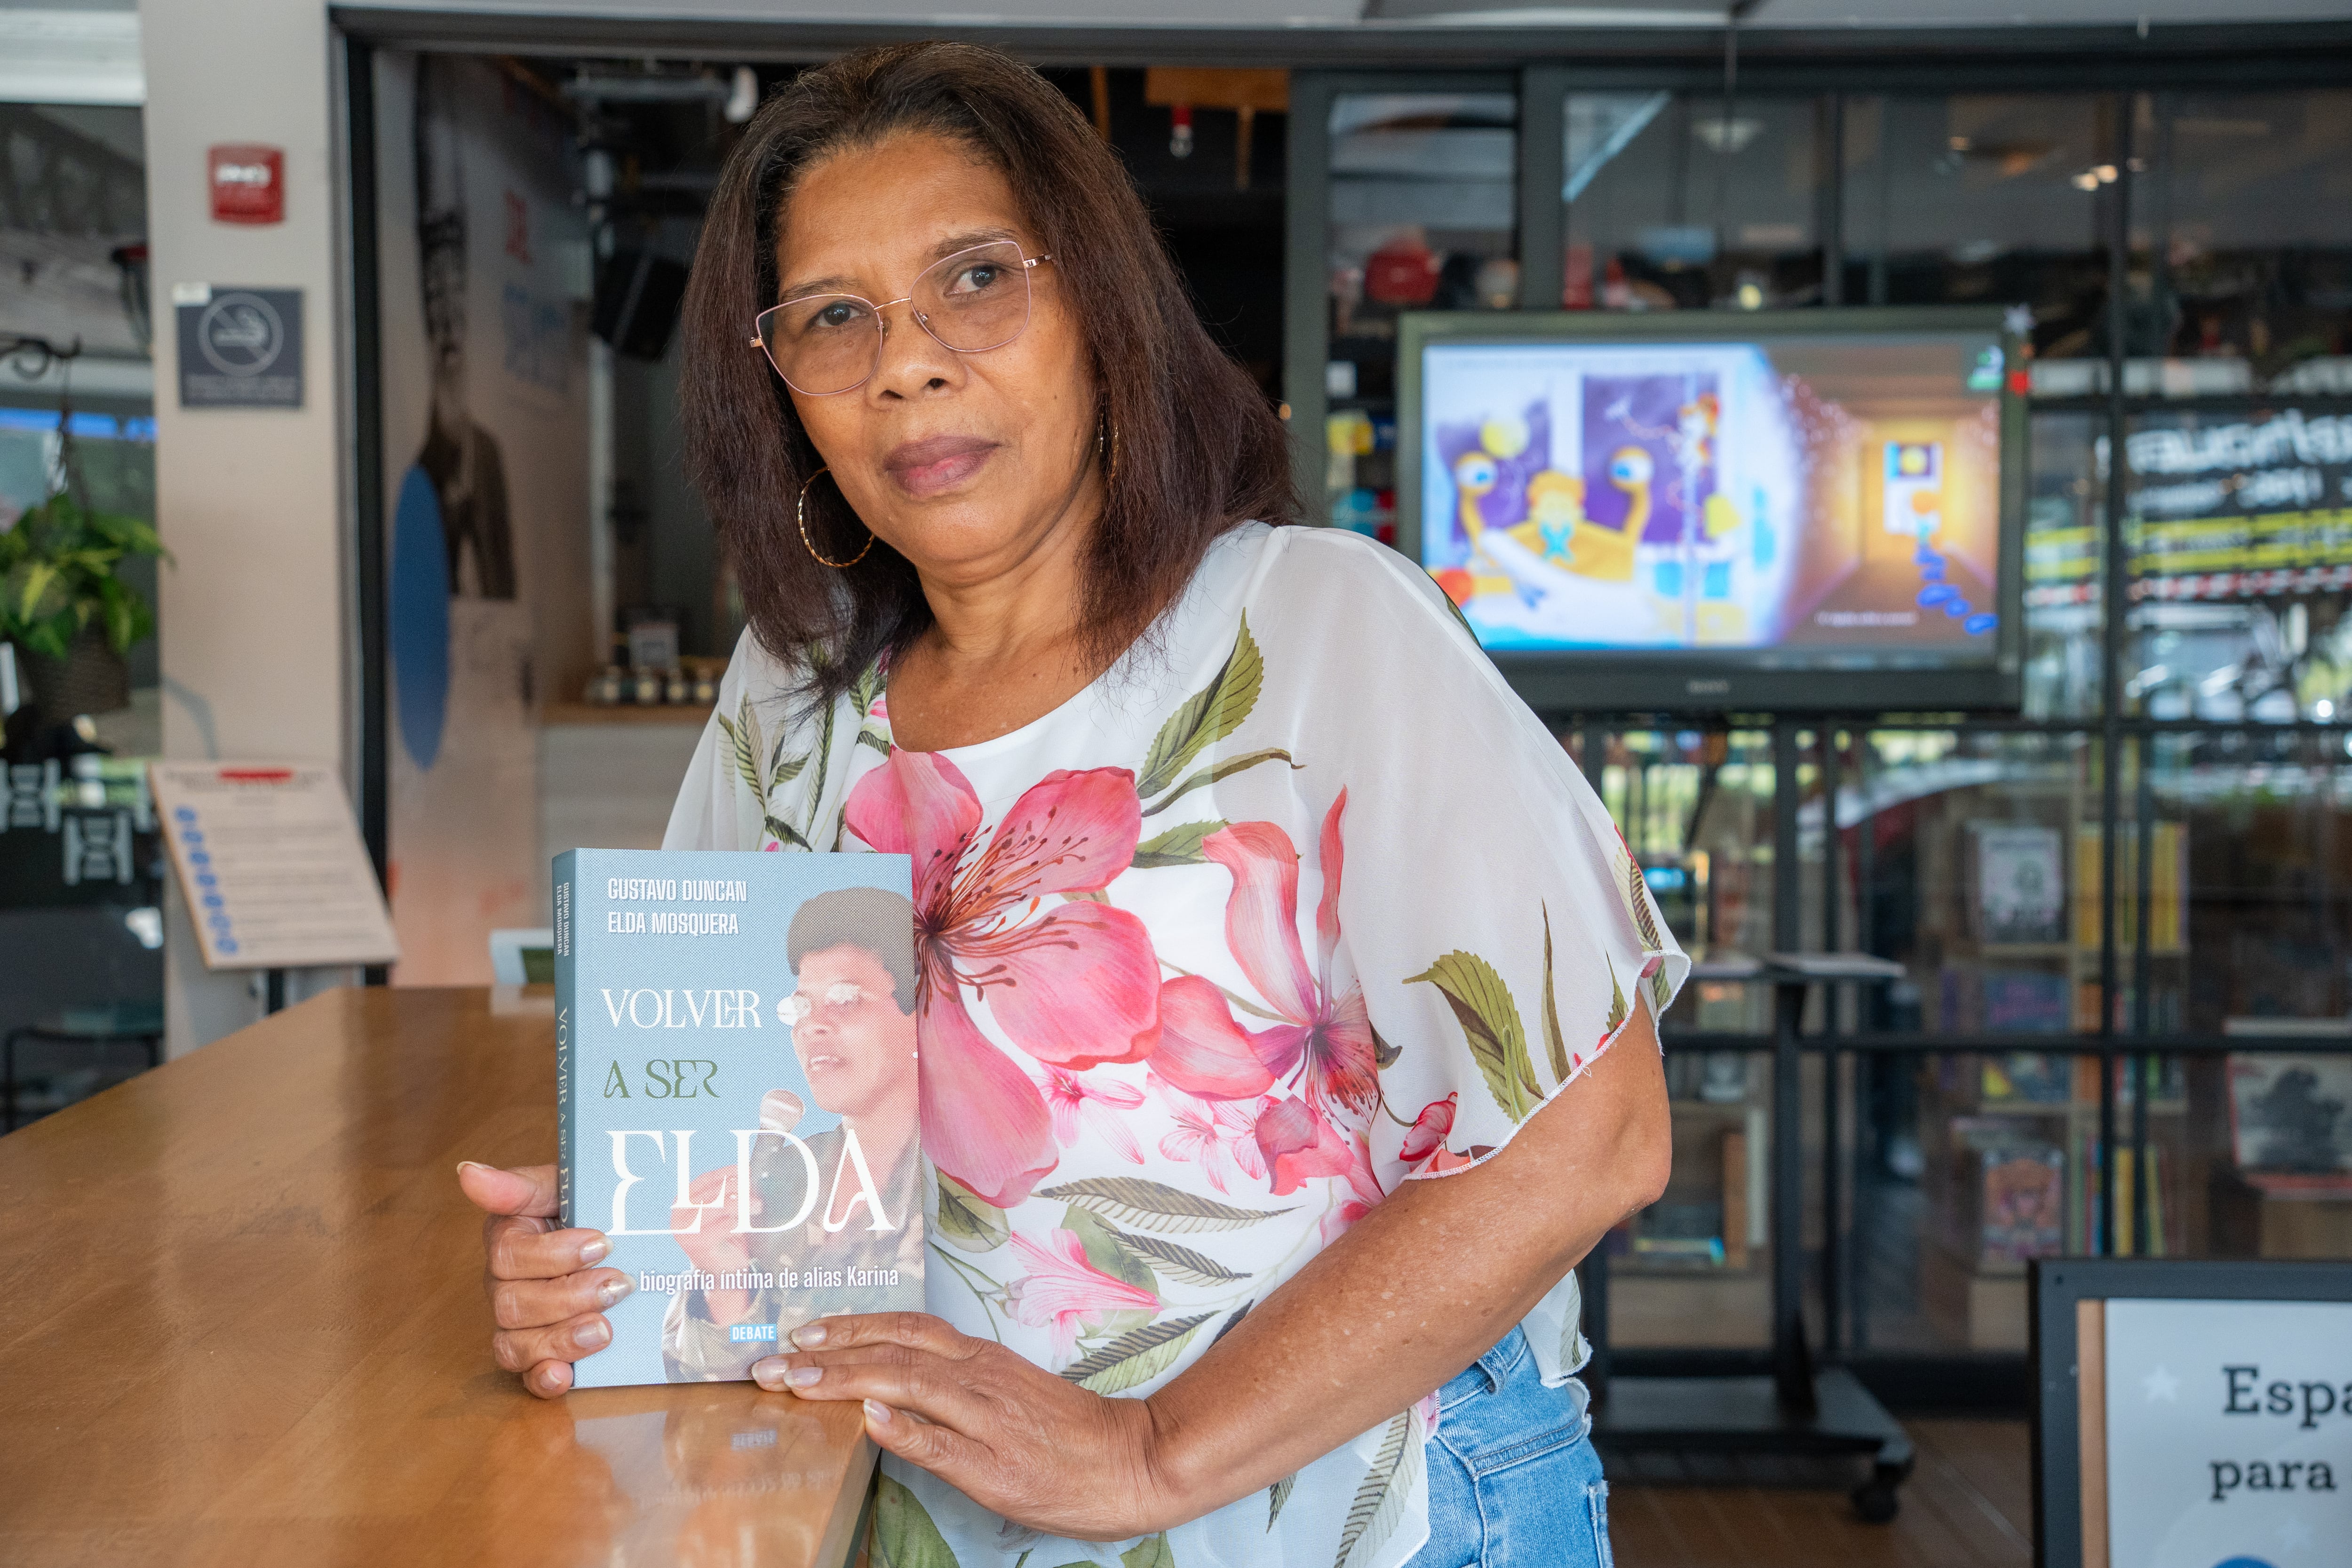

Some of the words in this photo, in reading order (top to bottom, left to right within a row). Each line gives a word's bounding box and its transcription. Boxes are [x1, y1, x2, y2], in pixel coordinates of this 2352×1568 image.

[608, 878, 677, 901] GUSTAVO
[683, 880, 747, 902] DUNCAN
[608, 911, 646, 933] ELDA
[652, 912, 739, 937] MOSQUERA
[601, 988, 763, 1029] VOLVER
[558, 1006, 567, 1105] VOLVER
[603, 1059, 632, 1099] A
[644, 1059, 721, 1099] SER
[560, 1113, 566, 1124] A
[560, 1167, 569, 1229] ELD
[605, 1128, 897, 1237] ELDA
[640, 1269, 715, 1295] biografía
[720, 1268, 774, 1290] íntima
[779, 1268, 798, 1289] de
[803, 1267, 842, 1288] alias
[847, 1266, 899, 1287] Karina
[732, 1325, 775, 1341] DEBATE
[2209, 1458, 2337, 1502] para
